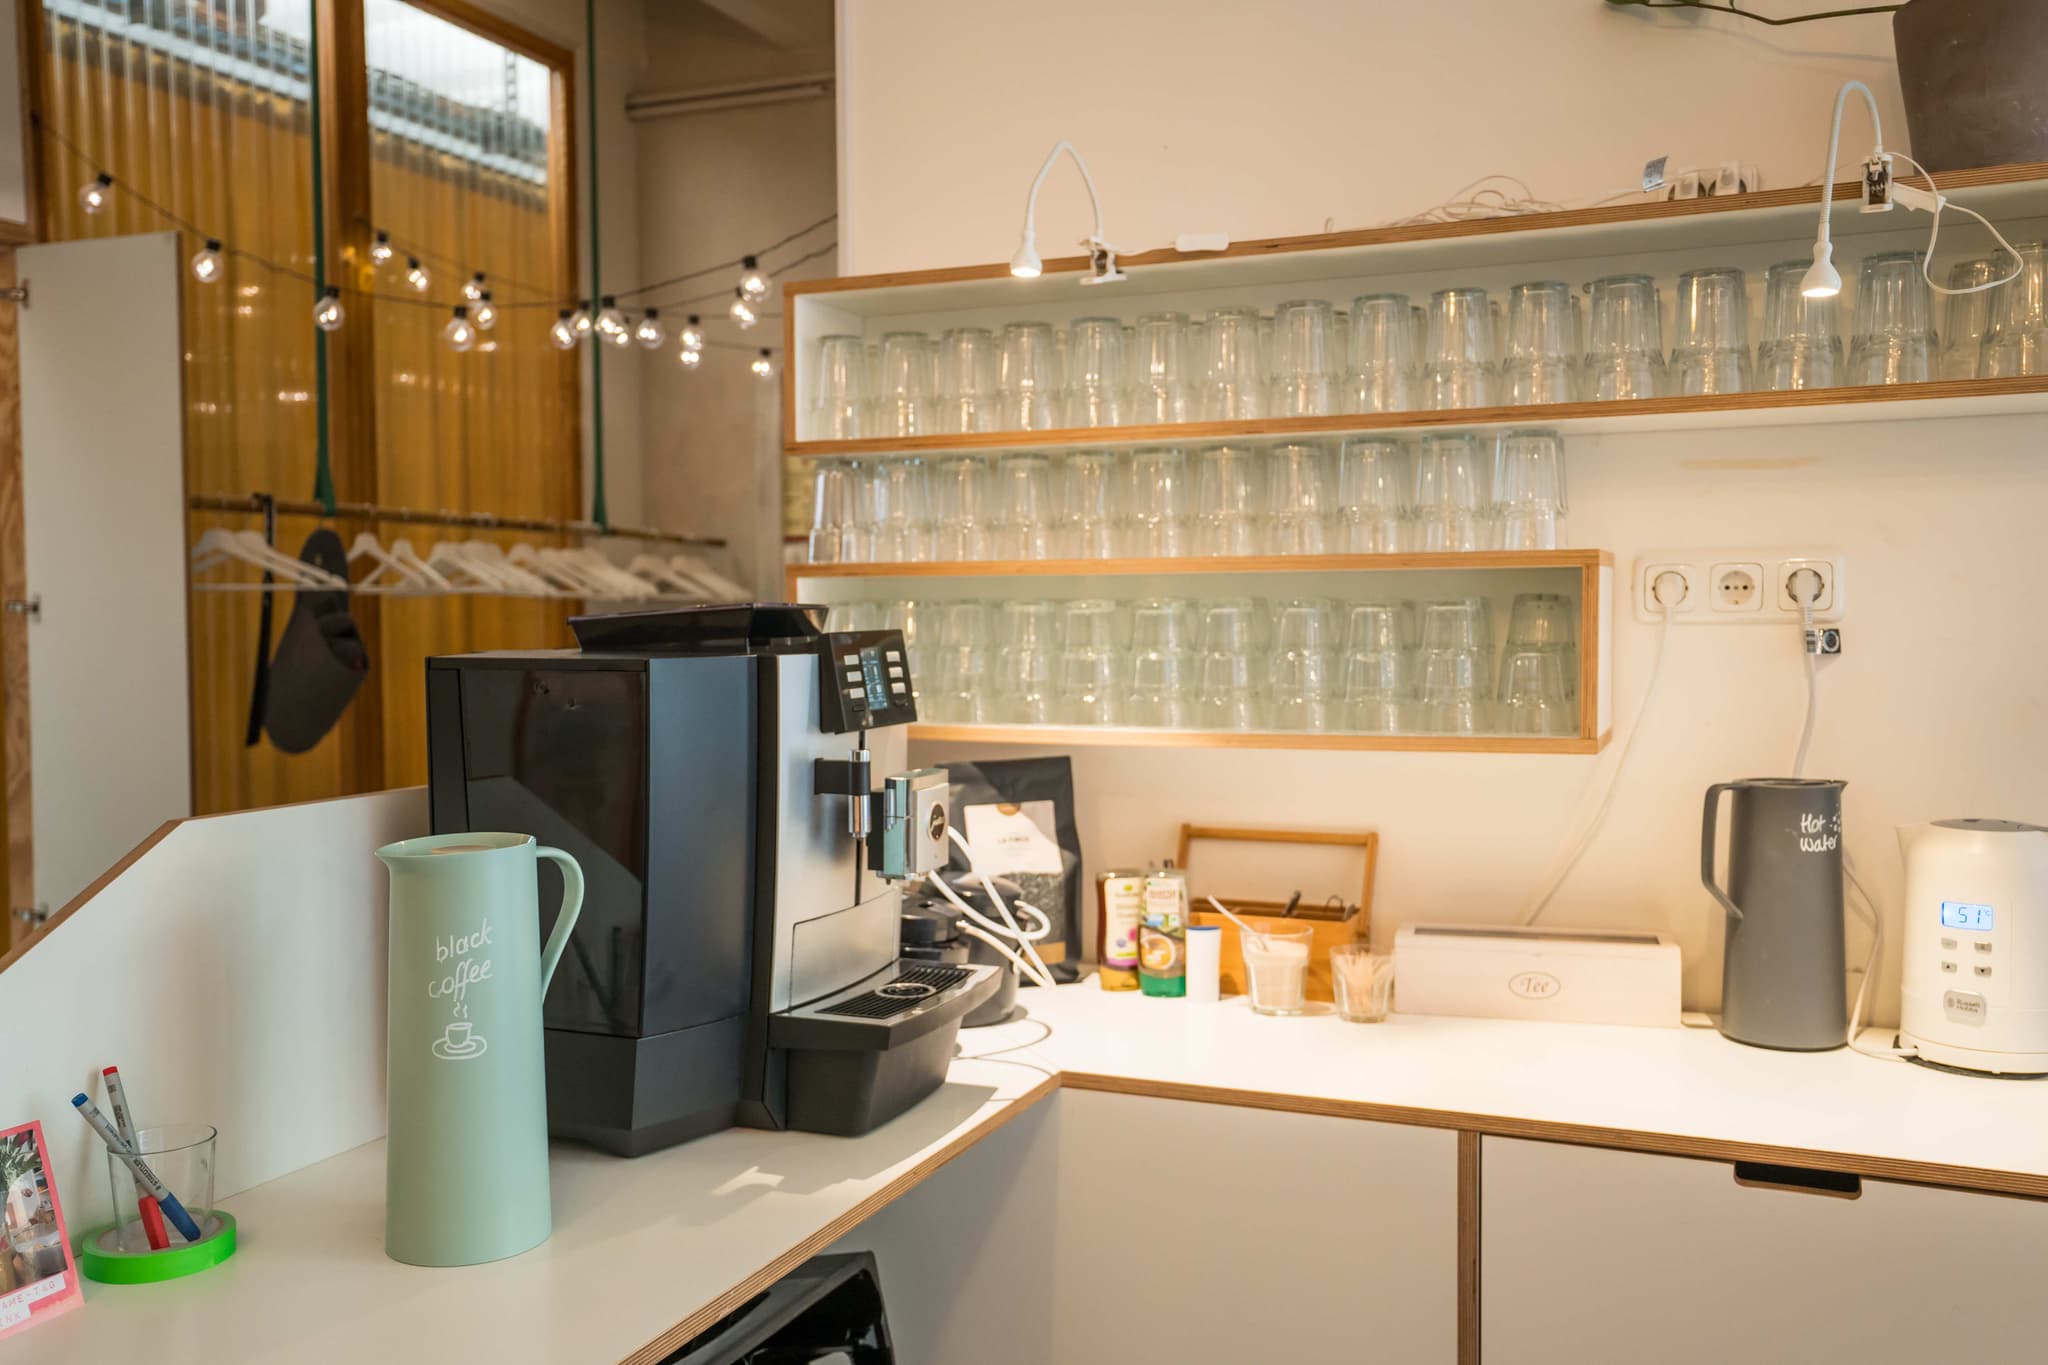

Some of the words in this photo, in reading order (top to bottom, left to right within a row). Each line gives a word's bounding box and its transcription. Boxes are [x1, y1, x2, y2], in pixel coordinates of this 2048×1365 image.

[1800, 812, 1827, 834] Hot
[436, 917, 493, 962] black
[428, 957, 493, 1002] coffee
